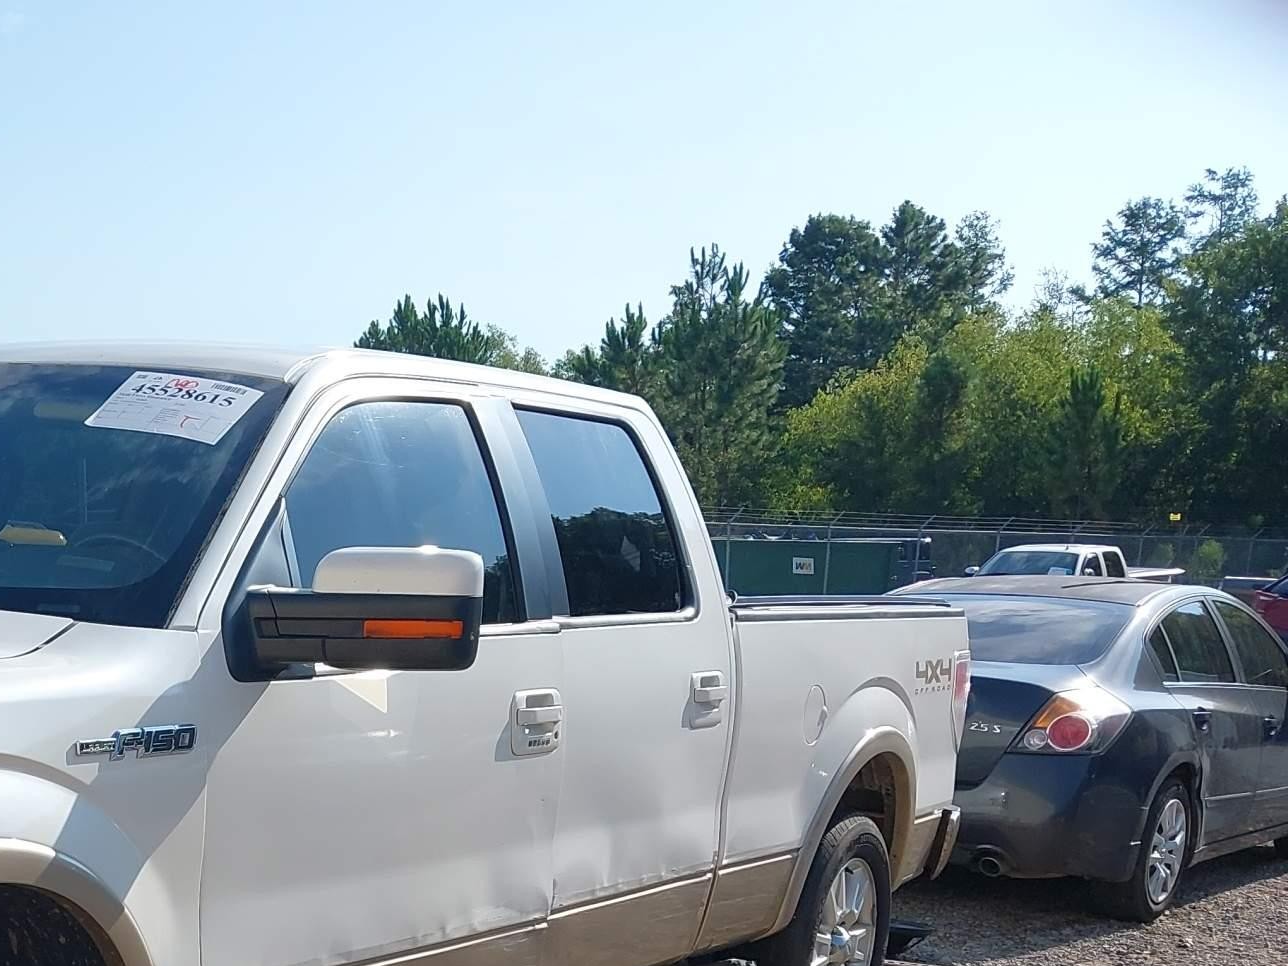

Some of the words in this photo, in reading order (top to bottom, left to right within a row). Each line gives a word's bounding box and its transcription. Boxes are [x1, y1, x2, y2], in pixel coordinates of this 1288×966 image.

[132, 383, 237, 407] 45528615
[915, 686, 929, 695] OFF
[931, 684, 951, 693] ROAD
[993, 725, 1001, 733] S
[112, 724, 197, 757] F-150
